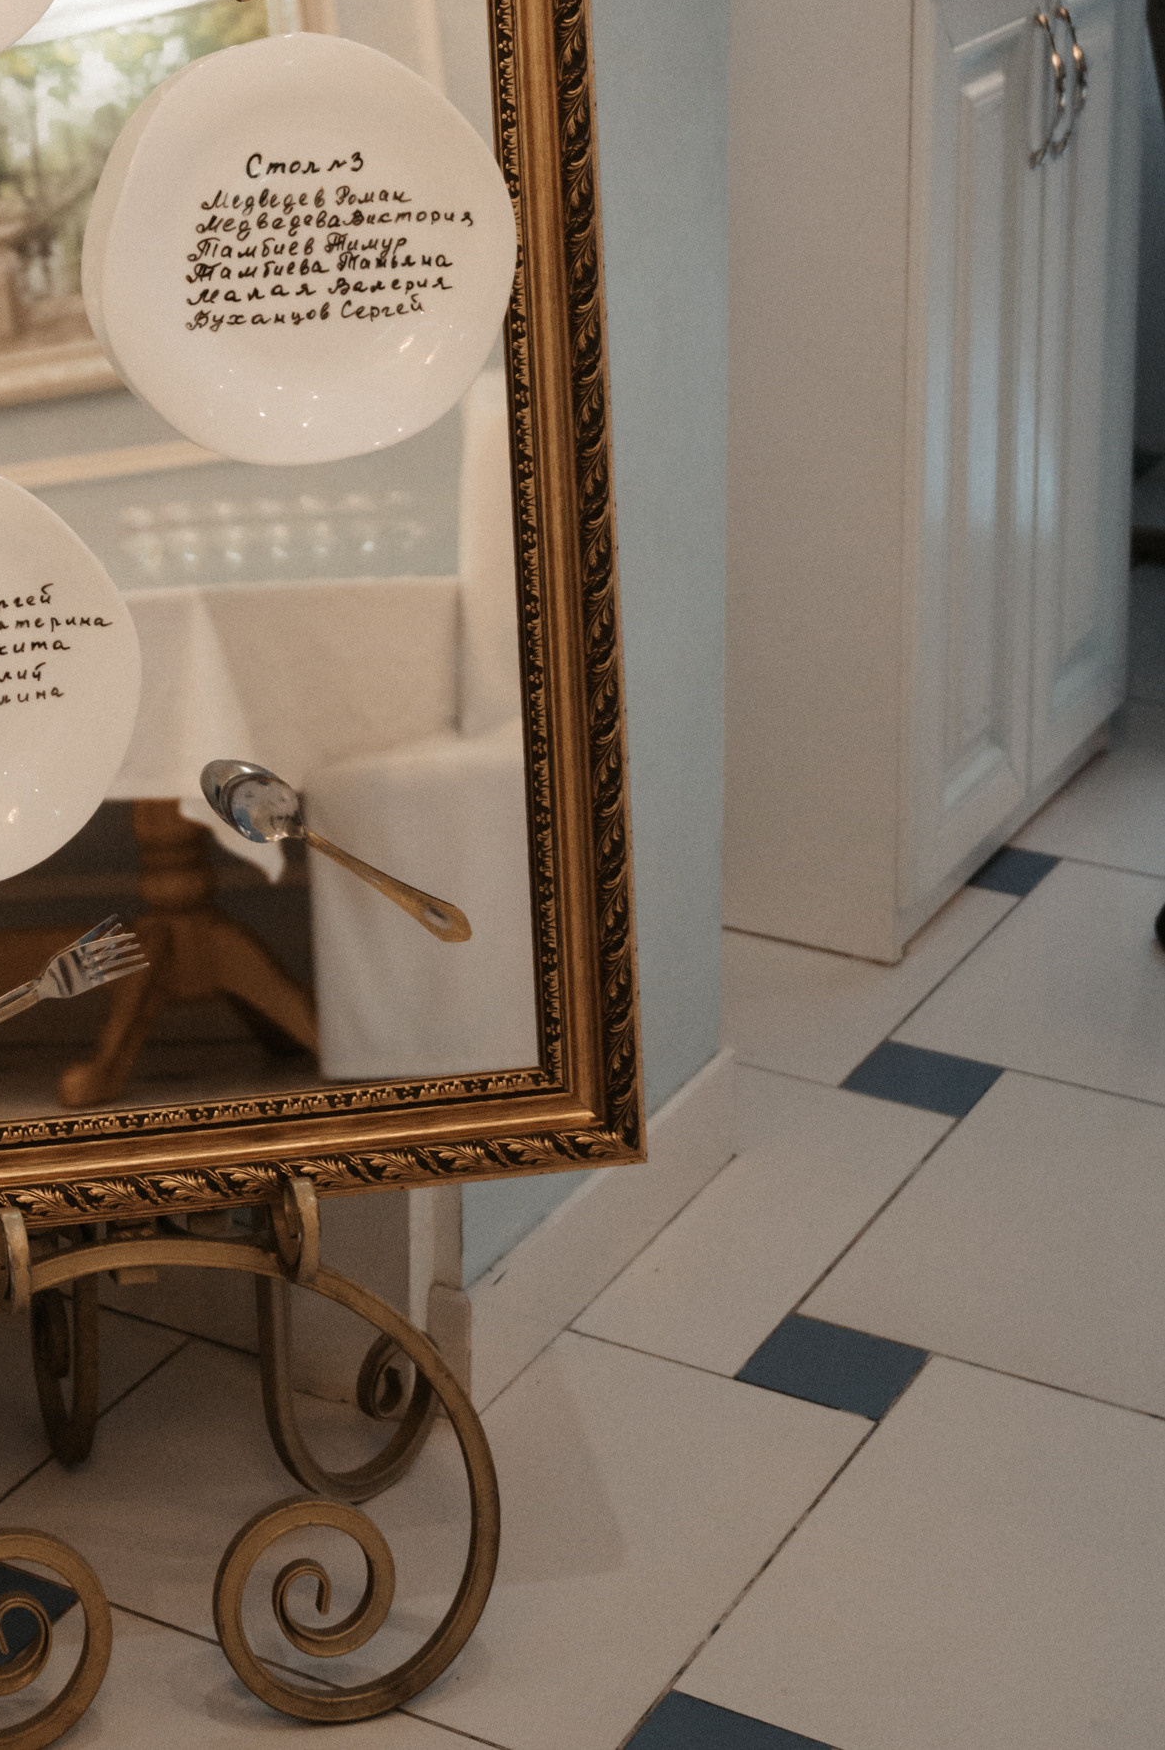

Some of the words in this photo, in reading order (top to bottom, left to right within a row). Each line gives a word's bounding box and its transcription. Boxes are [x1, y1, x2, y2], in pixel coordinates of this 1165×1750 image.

[246, 153, 320, 179] Стол
[350, 151, 364, 172] 3
[201, 187, 325, 215] Медведев
[335, 186, 412, 207] Роман
[196, 211, 341, 241] Медведева
[341, 208, 474, 227] Виктория
[187, 237, 315, 262] Тамбиев
[324, 232, 407, 256] Тимур
[186, 257, 329, 283] Тамбиева
[337, 252, 453, 272] Татьяна
[328, 277, 453, 296] Валерия
[186, 301, 330, 332] Буханцов
[340, 294, 423, 322] Сергей
